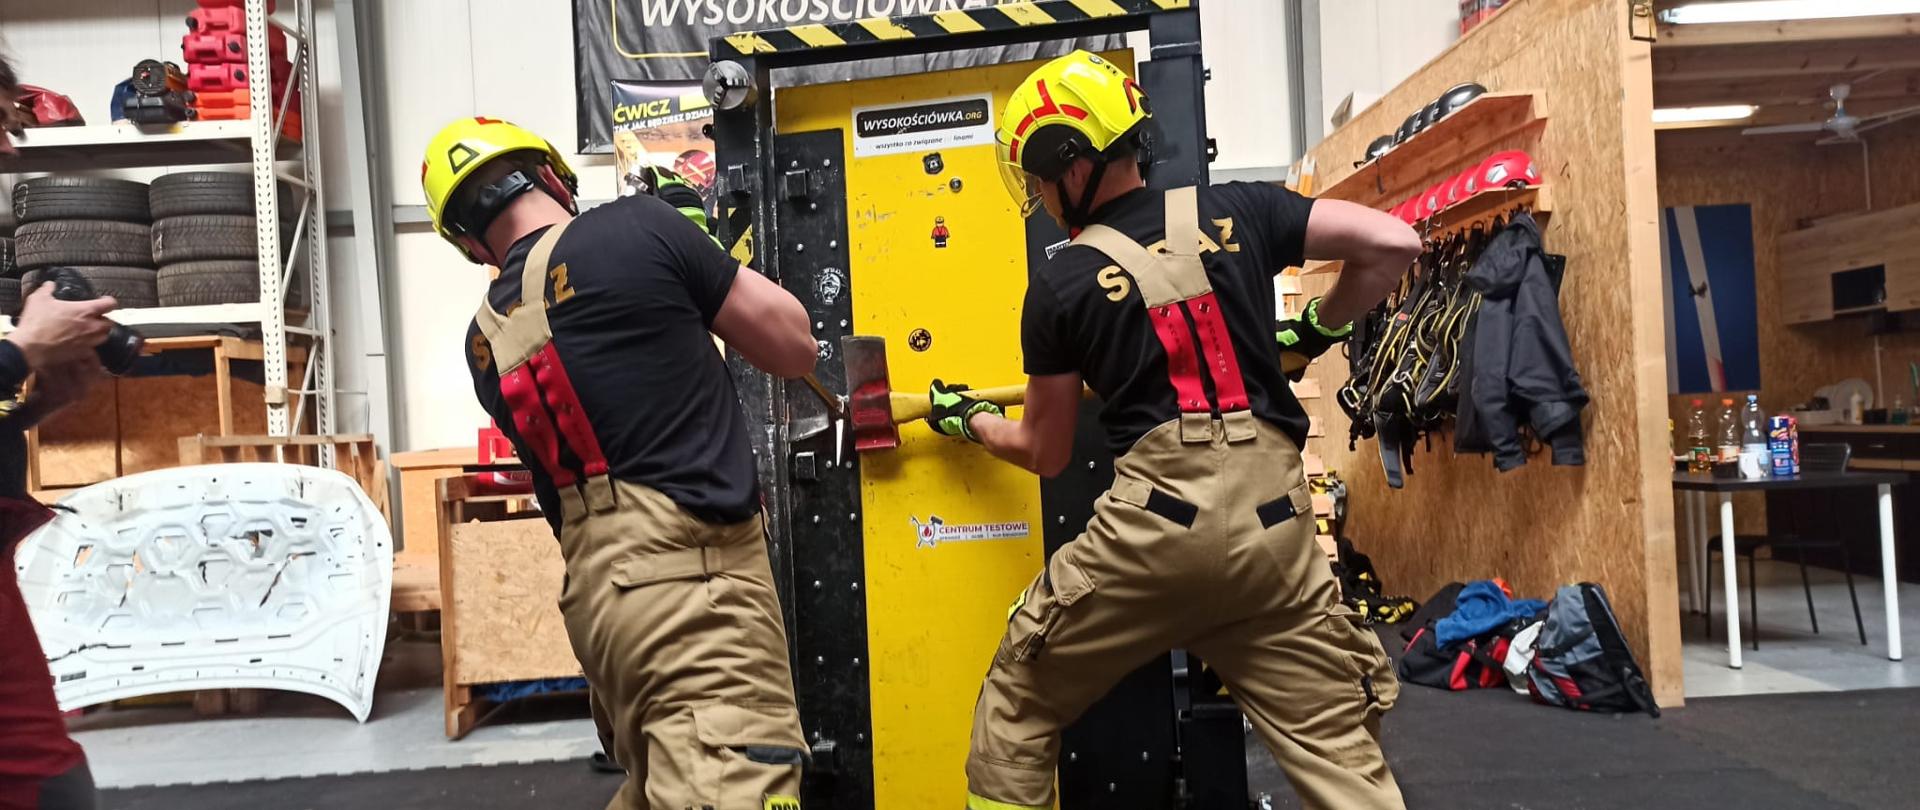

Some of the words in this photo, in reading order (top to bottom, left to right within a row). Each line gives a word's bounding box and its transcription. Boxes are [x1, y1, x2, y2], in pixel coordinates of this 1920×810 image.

[614, 99, 671, 122] ĆWICZ
[614, 124, 630, 132] TAK
[631, 121, 647, 129] JAK
[685, 109, 714, 120] DZIAŁA
[864, 110, 983, 132] WYSOKOŚCIÓWKA.ORG
[939, 525, 982, 535] CENTRUM
[984, 522, 1028, 532] TESTOWE
